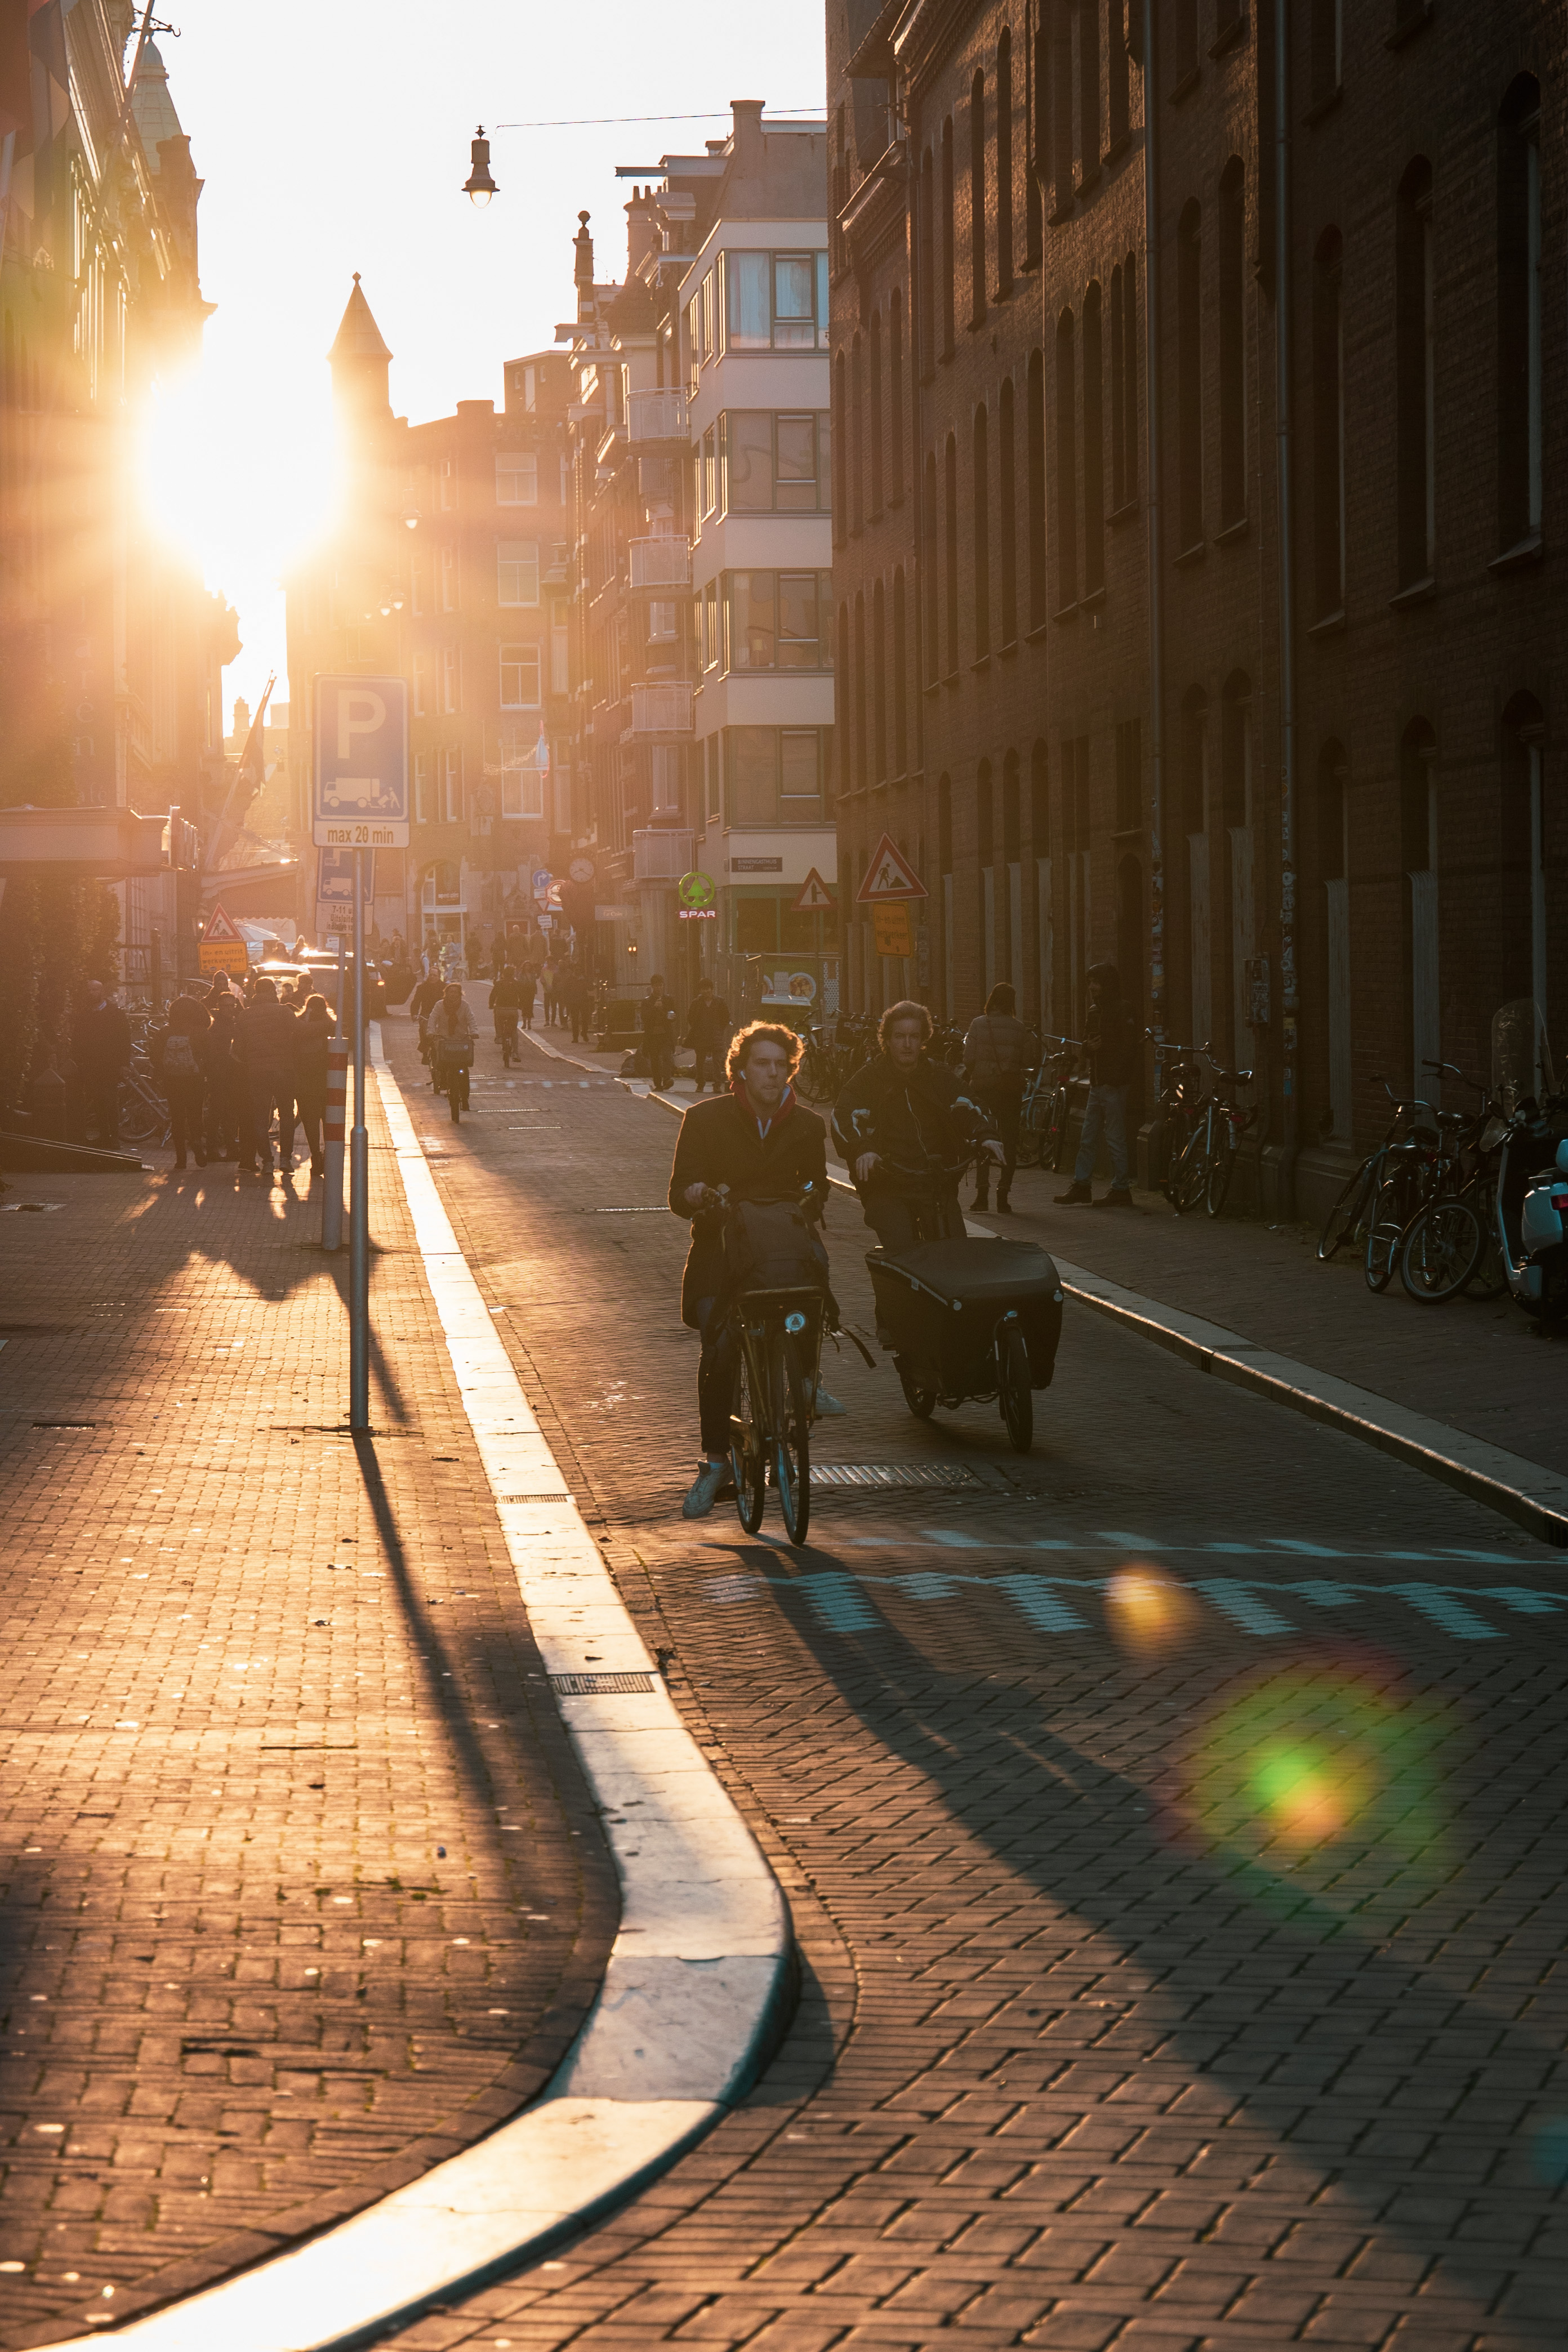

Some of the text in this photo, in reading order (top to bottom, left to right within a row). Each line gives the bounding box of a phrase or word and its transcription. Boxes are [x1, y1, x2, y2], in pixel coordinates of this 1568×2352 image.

[338, 688, 386, 759] P
[327, 826, 394, 844] max 20 min
[332, 905, 346, 914] 7-11
[331, 914, 354, 923] Uitsluite
